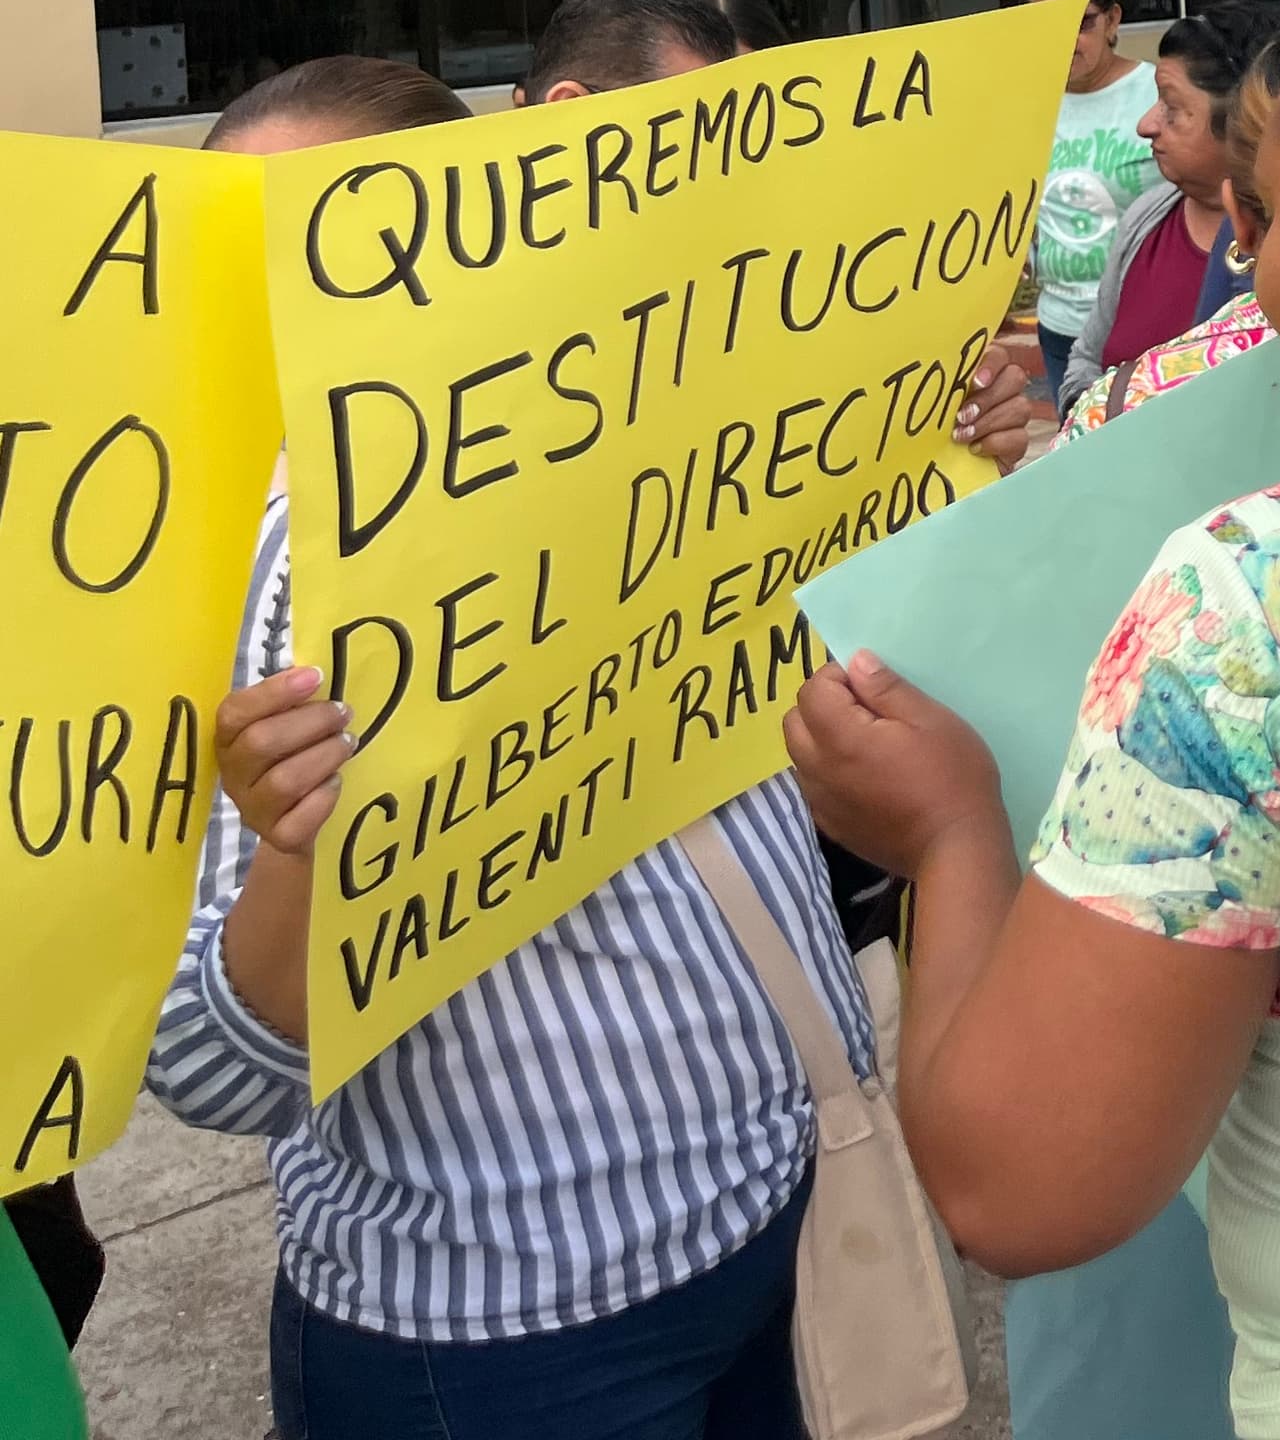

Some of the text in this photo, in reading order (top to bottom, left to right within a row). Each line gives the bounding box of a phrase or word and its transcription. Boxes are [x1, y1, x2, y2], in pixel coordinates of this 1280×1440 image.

[306, 49, 934, 306] QUEREMOS LA
[328, 178, 1038, 558] DESTITUCION
[331, 327, 989, 757] DEL DIRECTOR
[339, 460, 956, 901] GILBERTO EDUARDO
[0, 694, 197, 858] URA
[340, 609, 836, 1014] VALENTI RAM
